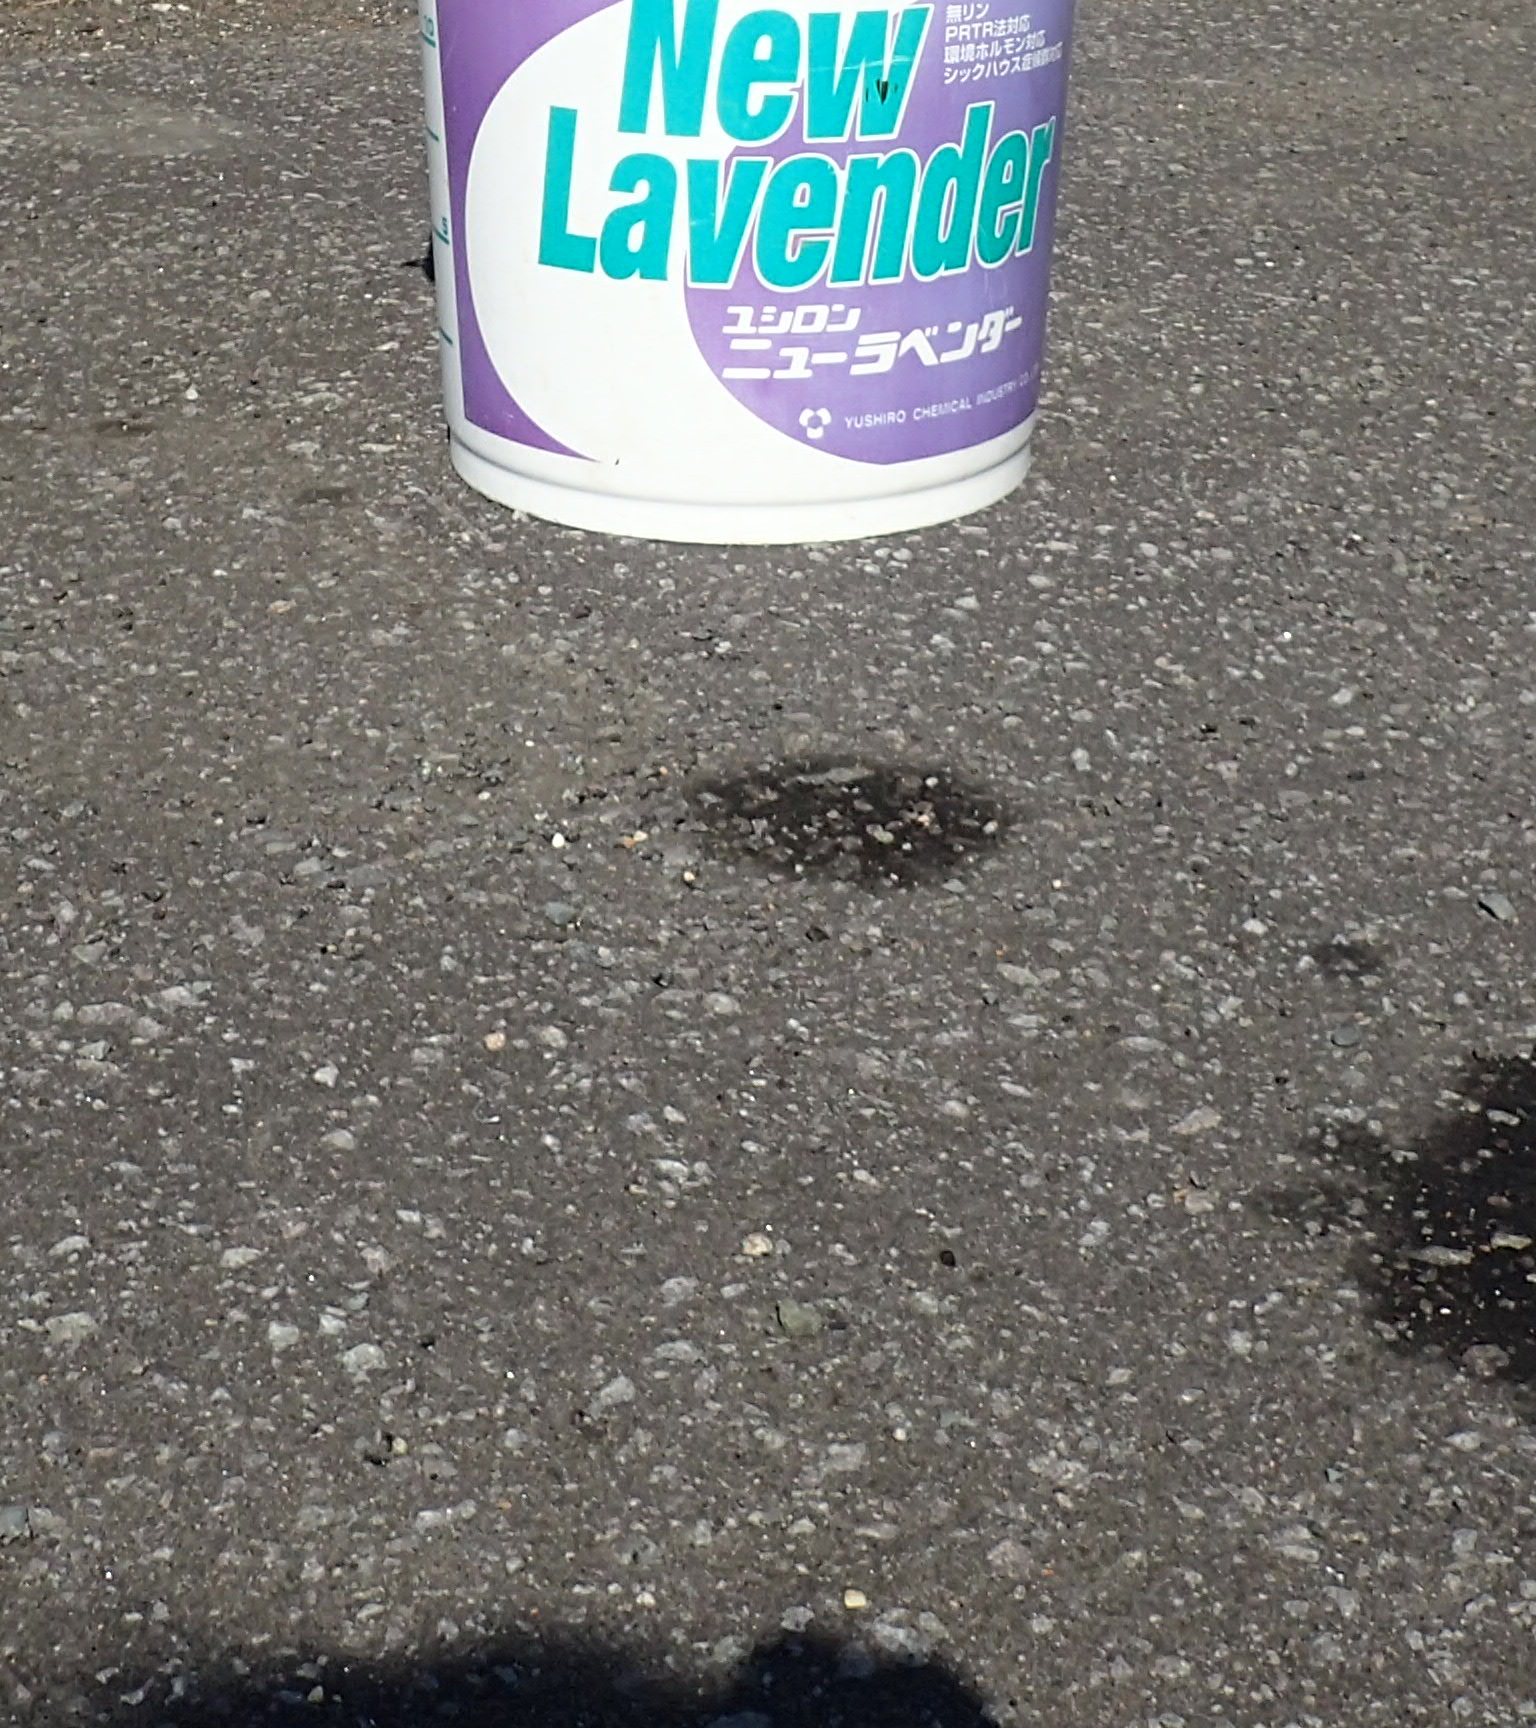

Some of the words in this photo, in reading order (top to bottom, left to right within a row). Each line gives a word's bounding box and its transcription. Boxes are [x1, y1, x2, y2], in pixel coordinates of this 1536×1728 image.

[945, 3, 990, 24] 無リン
[945, 14, 1031, 43] PRTR法対応
[943, 29, 1046, 64] 環境ホルモン対応
[538, 99, 1056, 291] Lavender
[722, 304, 862, 334] ユシロン
[844, 409, 906, 429] YUSHIRO
[913, 396, 973, 421] CHEMICAL
[975, 381, 1017, 406] INDUSTRY
